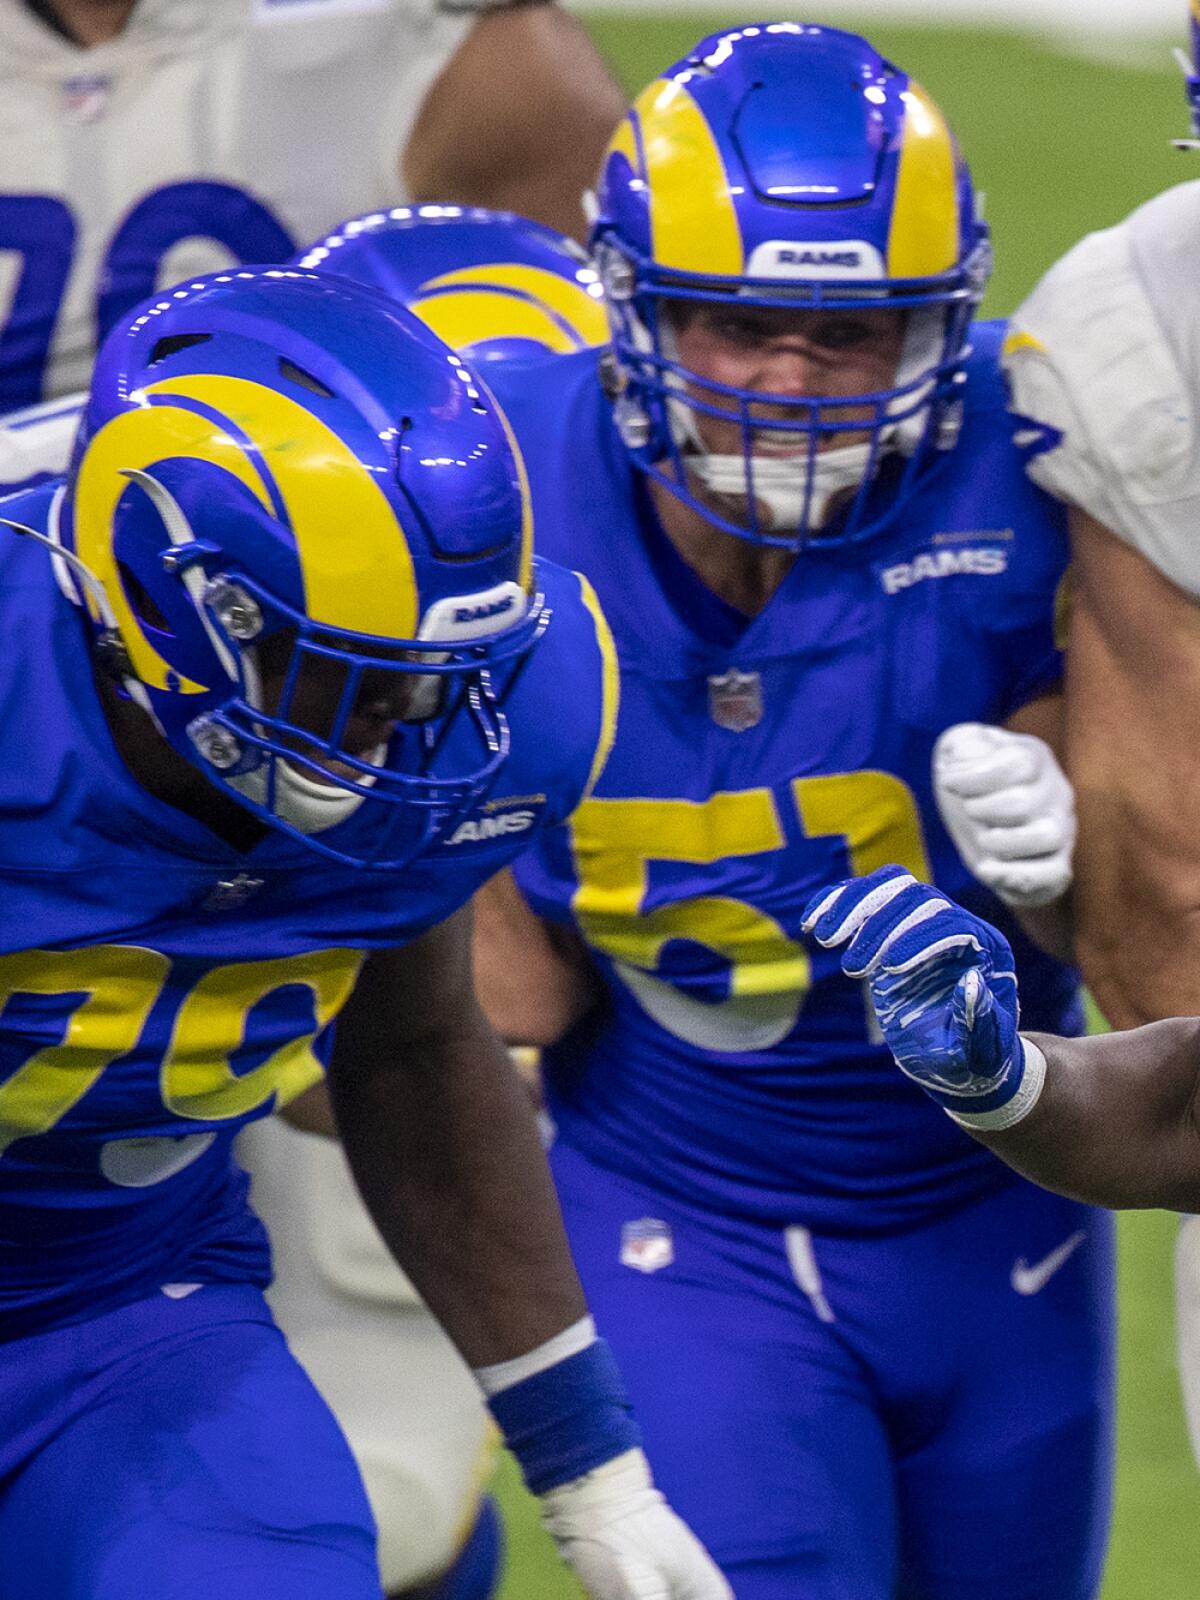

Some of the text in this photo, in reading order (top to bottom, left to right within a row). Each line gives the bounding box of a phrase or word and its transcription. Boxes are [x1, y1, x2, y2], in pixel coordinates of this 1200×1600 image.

[777, 249, 861, 268] RAMS
[880, 549, 1008, 595] RAMS
[453, 594, 516, 623] RAMS
[443, 809, 536, 846] AMS
